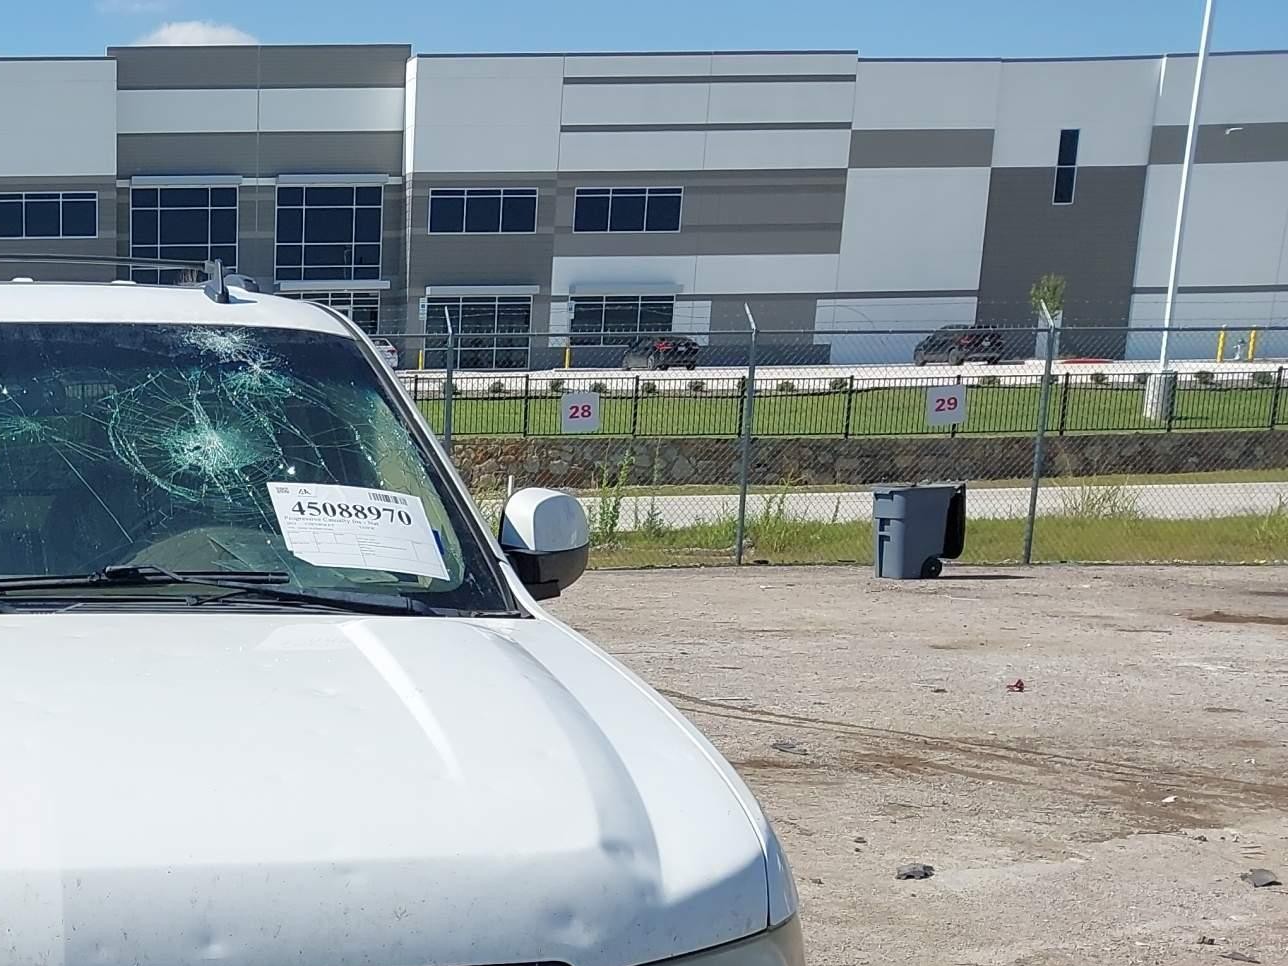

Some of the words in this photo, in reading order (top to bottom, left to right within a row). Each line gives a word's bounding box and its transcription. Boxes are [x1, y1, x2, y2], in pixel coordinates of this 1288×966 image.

[569, 404, 592, 419] 28
[935, 396, 958, 412] 29
[291, 500, 412, 526] 45088970
